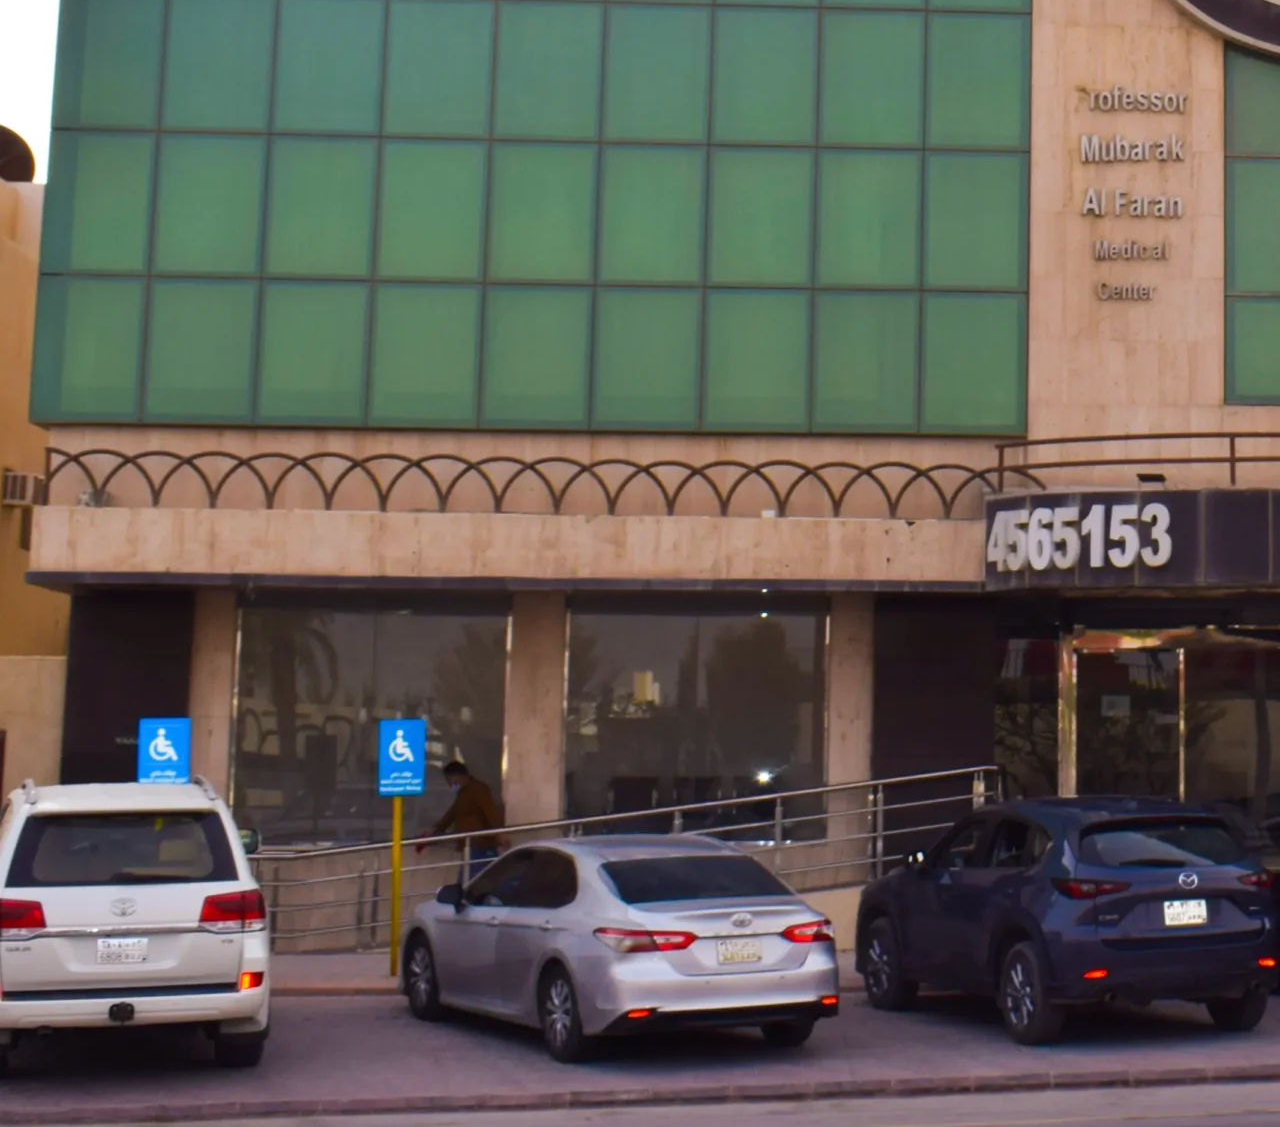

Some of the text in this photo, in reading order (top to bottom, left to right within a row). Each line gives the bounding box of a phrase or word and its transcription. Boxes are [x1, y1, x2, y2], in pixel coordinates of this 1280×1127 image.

[1080, 134, 1185, 164] Mubarak
[1082, 187, 1183, 218] Al Faran
[1094, 239, 1169, 262] Medical
[1099, 281, 1156, 301] Center
[987, 502, 1173, 573] 4565153
